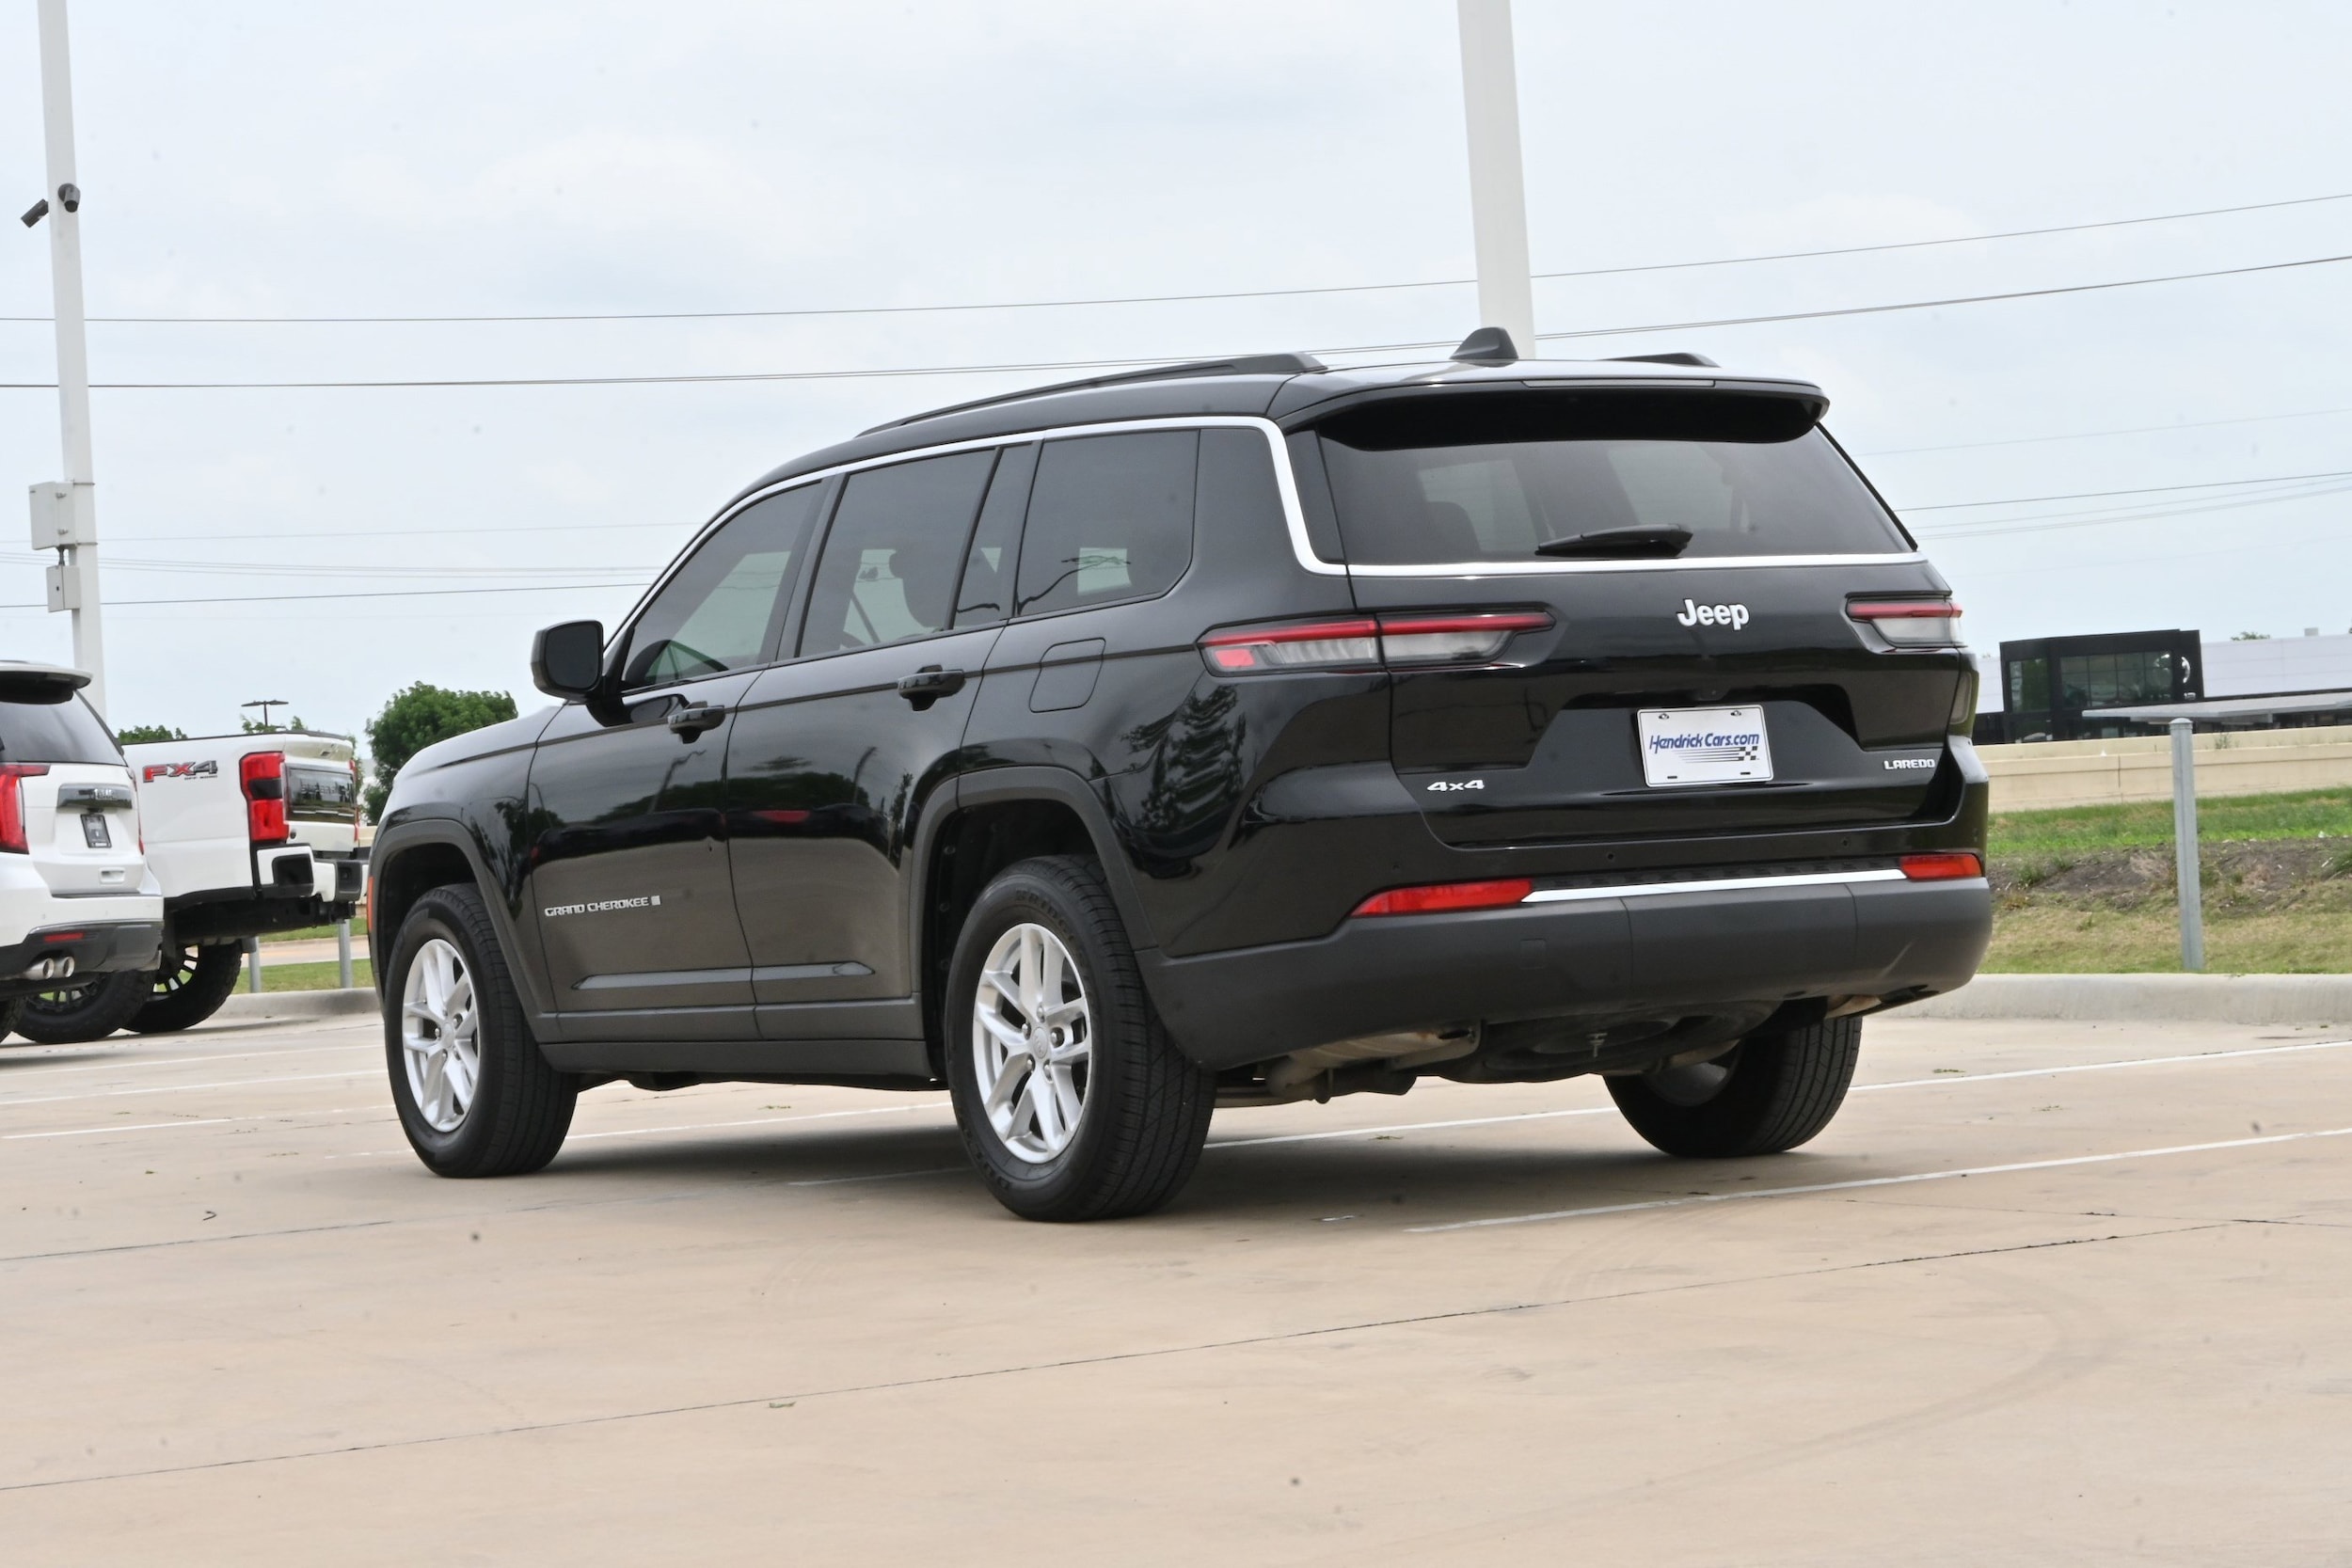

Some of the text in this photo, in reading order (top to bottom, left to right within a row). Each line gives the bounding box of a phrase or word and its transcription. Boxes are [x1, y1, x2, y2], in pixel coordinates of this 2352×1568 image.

[1677, 598, 1750, 630] Jeep
[1649, 733, 1760, 754] Hendrick Cars.com
[142, 760, 217, 783] FX4
[1883, 758, 1936, 770] LAREDO
[1426, 779, 1486, 792] 4x4
[545, 903, 585, 917] GRAND
[587, 896, 649, 912] CHEROKEE
